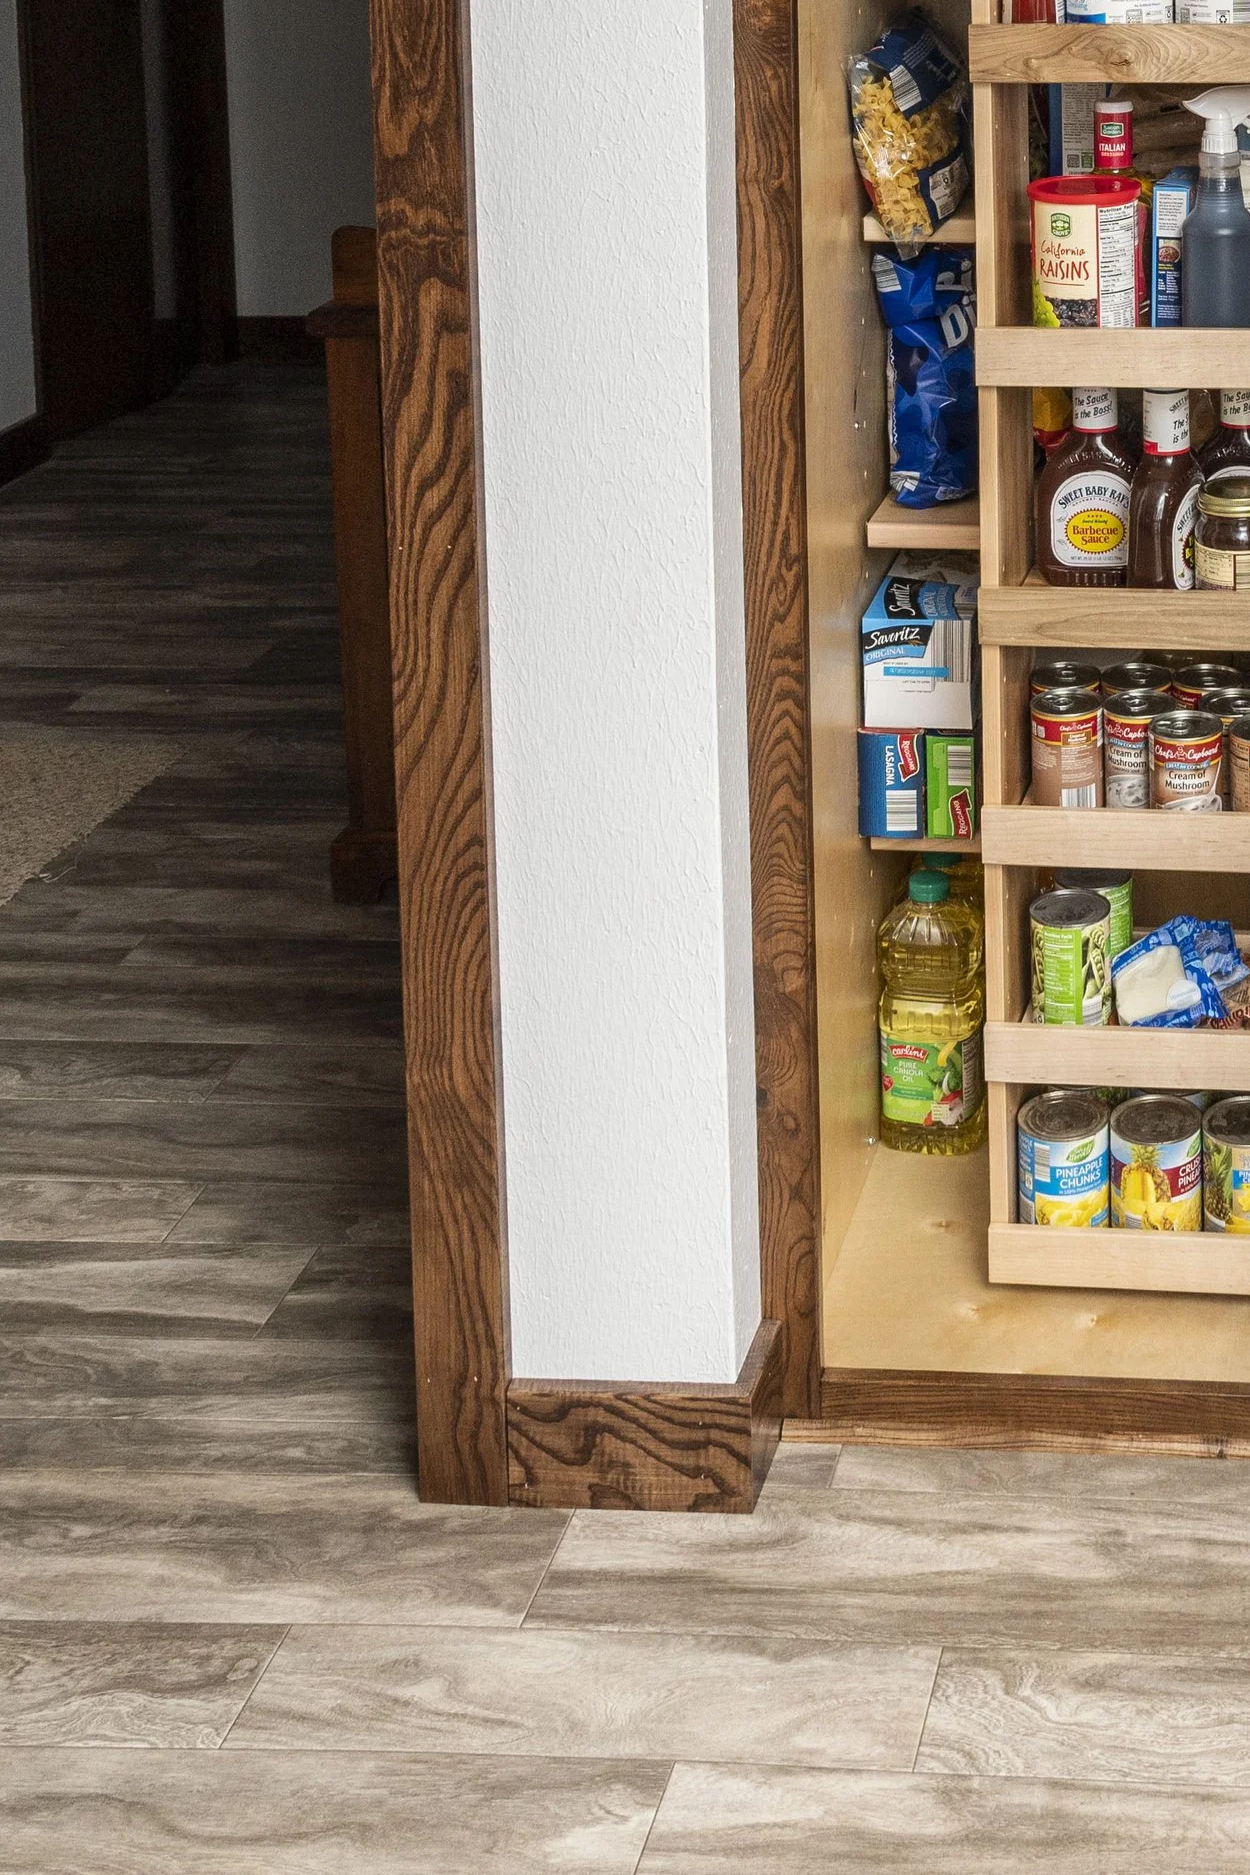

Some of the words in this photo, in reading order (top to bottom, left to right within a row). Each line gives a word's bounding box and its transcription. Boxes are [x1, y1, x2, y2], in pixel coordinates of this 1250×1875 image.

[1098, 143, 1126, 152] ITALIAN
[1040, 239, 1086, 259] California
[1040, 259, 1090, 281] RAISINS
[1074, 397, 1086, 407] The
[1086, 393, 1110, 406] Sauce
[1223, 393, 1234, 403] The
[1080, 407, 1092, 419] the
[1093, 401, 1113, 416] Boss!
[1223, 407, 1229, 416] is
[1229, 403, 1242, 415] the
[1172, 419, 1184, 431] The
[1172, 434, 1180, 445] is
[1058, 487, 1084, 509] SWEET
[1084, 485, 1109, 497] BABY
[1108, 489, 1131, 509] RAY'S
[1072, 525, 1119, 535] Barbecue
[1080, 535, 1110, 545] Sauce
[864, 626, 921, 650] Savoritz
[865, 647, 906, 661] ORIGINAL
[901, 740, 916, 771] REGGANO
[1108, 745, 1132, 759] Cream
[1133, 747, 1143, 759] of
[1154, 744, 1176, 759] Chef's
[1186, 742, 1220, 761] Cupboard
[885, 745, 895, 787] LASAGNA
[1107, 753, 1147, 769] Mushroom
[1168, 770, 1194, 781] Cream
[1194, 770, 1206, 779] of
[1164, 779, 1210, 791] Mushroom
[953, 800, 968, 835] REGGANO
[892, 1045, 924, 1059] carlini
[893, 1066, 924, 1077] CANOLA
[898, 1060, 917, 1070] PURE
[902, 1075, 913, 1083] OIL
[1056, 1157, 1103, 1179] PINEAPPLE
[1179, 1156, 1200, 1177] CRUS
[1060, 1169, 1101, 1189] CHUNKS
